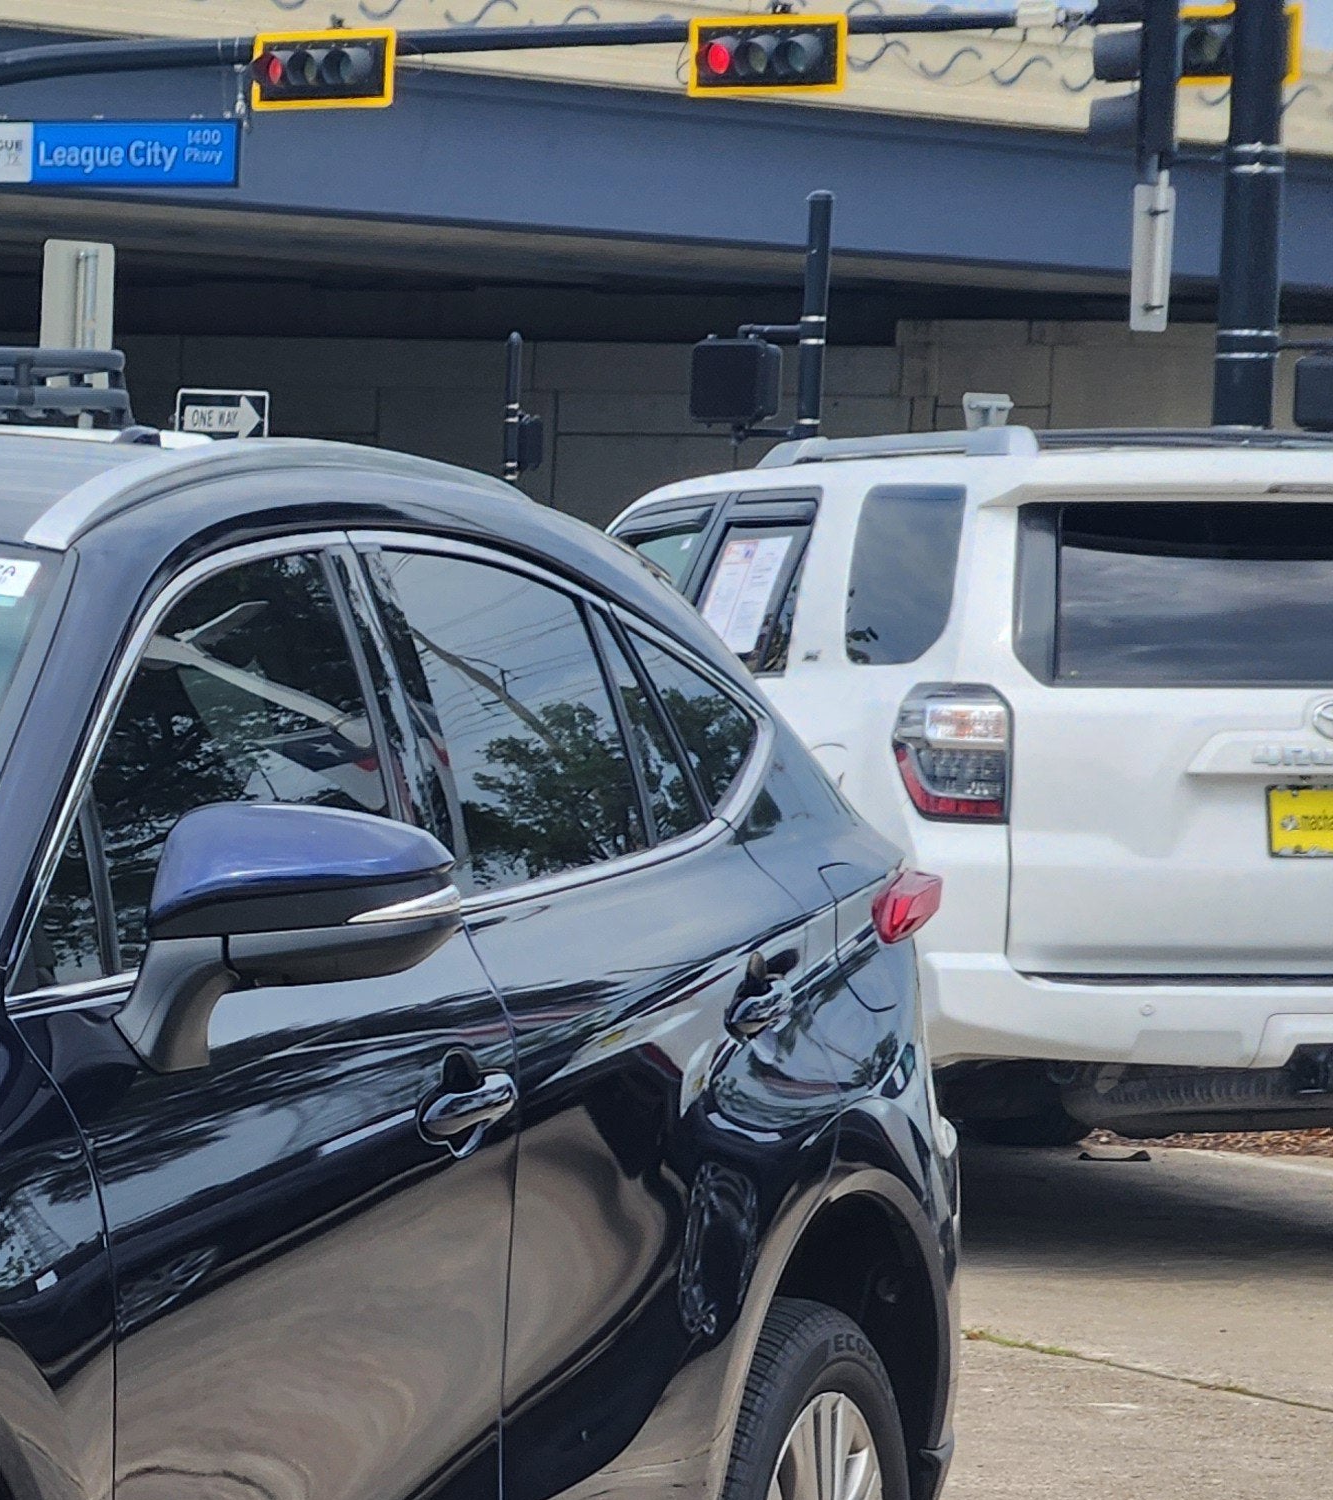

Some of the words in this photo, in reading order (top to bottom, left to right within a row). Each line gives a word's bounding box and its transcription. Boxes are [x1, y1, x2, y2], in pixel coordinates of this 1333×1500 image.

[38, 141, 125, 174] League
[128, 140, 178, 172] City
[184, 149, 223, 165] Pkwy
[192, 409, 213, 427] ONE
[218, 410, 239, 427] WAY
